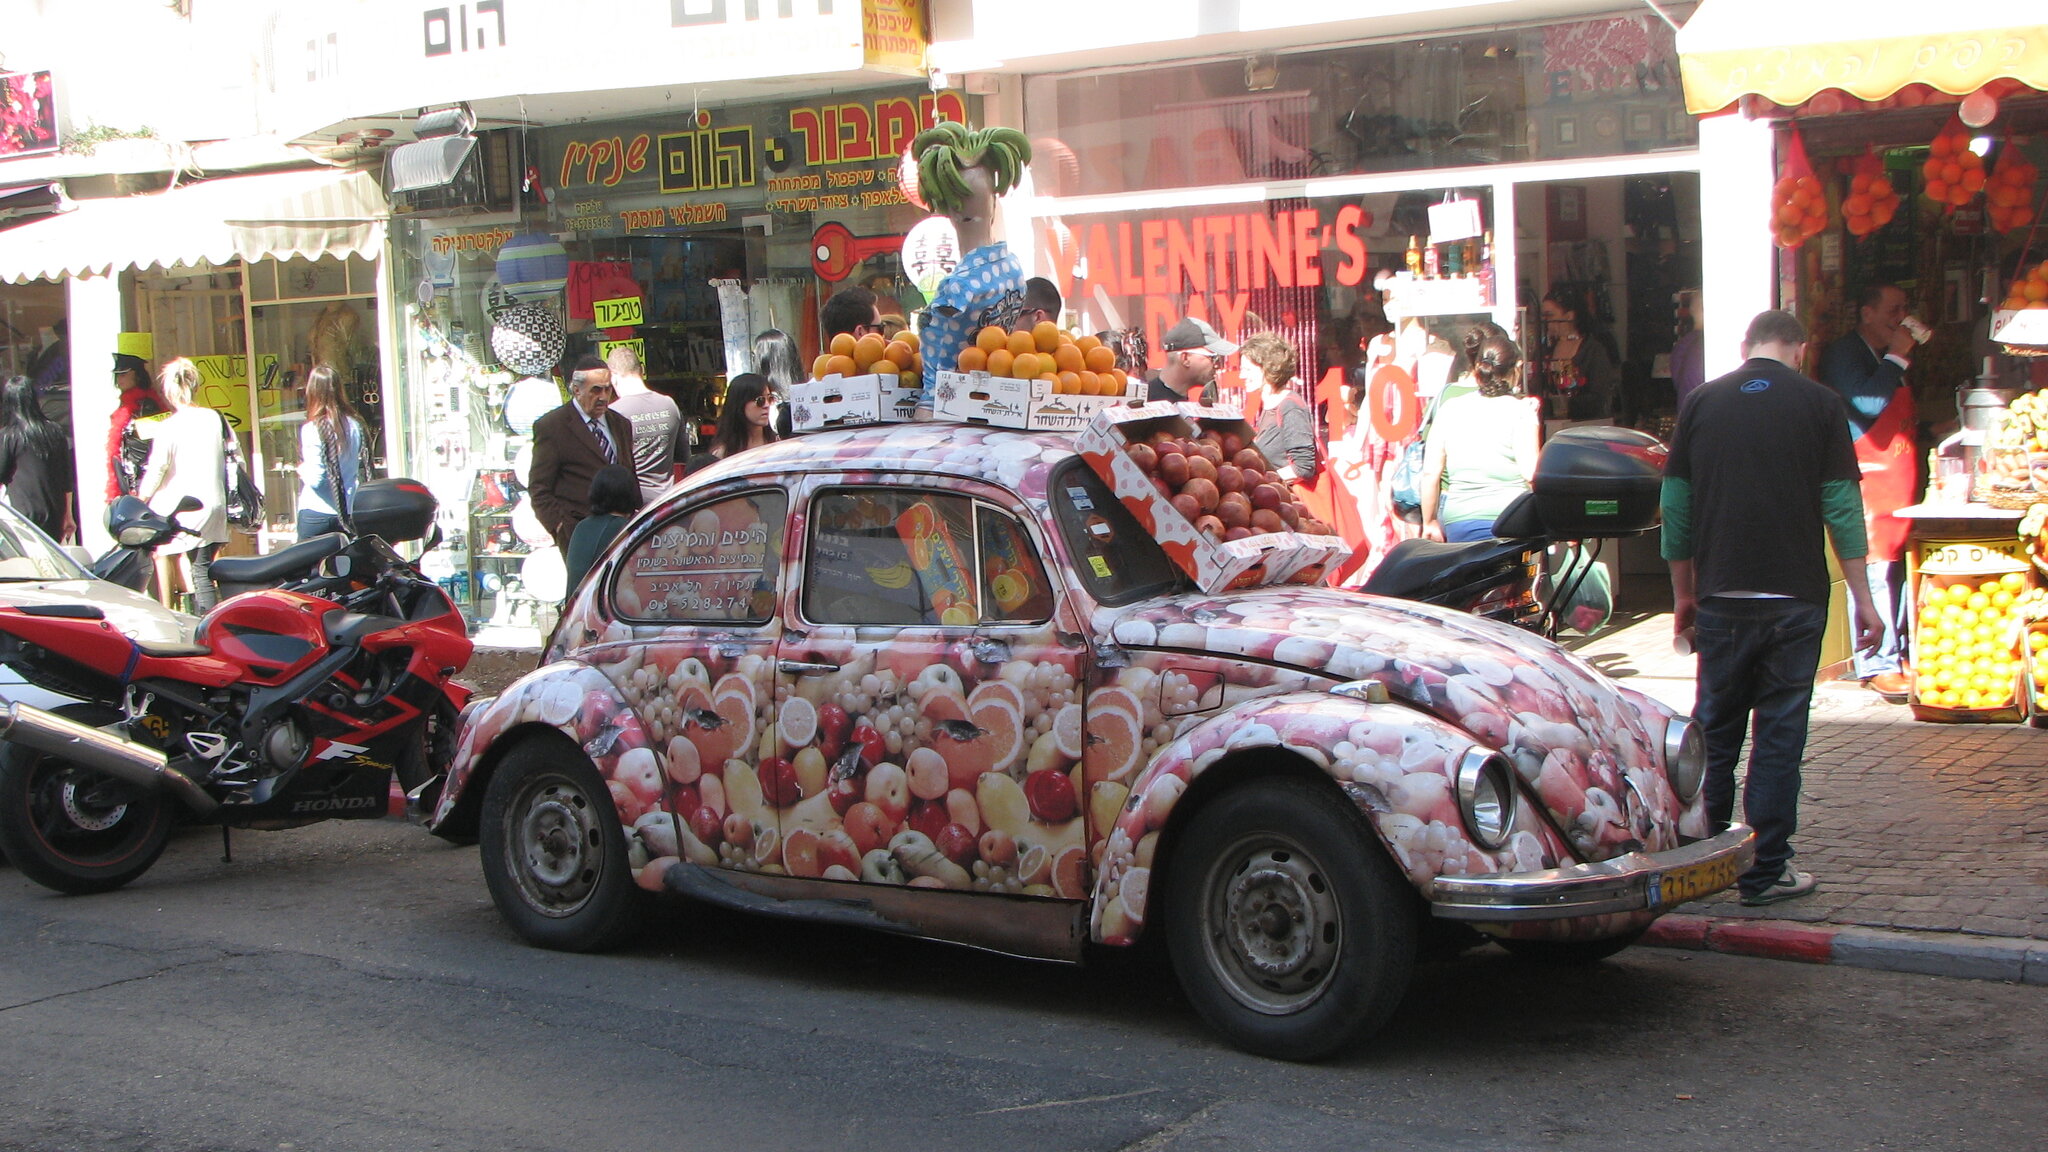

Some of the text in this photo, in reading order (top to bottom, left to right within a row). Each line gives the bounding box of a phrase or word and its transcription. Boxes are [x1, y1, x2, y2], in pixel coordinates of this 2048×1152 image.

[423, 0, 506, 57] הום
[864, 8, 913, 33] שיכפול
[560, 133, 651, 188] שנקין
[767, 174, 822, 192] מפתחות
[825, 168, 875, 186] שיכפול
[775, 197, 819, 213] משרדי
[821, 194, 849, 209] ציוד
[620, 202, 727, 235] חשמלאי מוסמך
[1046, 204, 1368, 298] VALENTINE'S
[595, 301, 642, 322] טמבור
[650, 528, 768, 549] היפים והמיצים
[636, 557, 669, 568] בשנקין
[671, 556, 715, 566] הראשונה
[719, 555, 757, 565] המיצים
[650, 582, 681, 592] אביב
[687, 579, 702, 592] תל
[648, 596, 748, 611] 03-528274
[292, 796, 377, 812] HONDA
